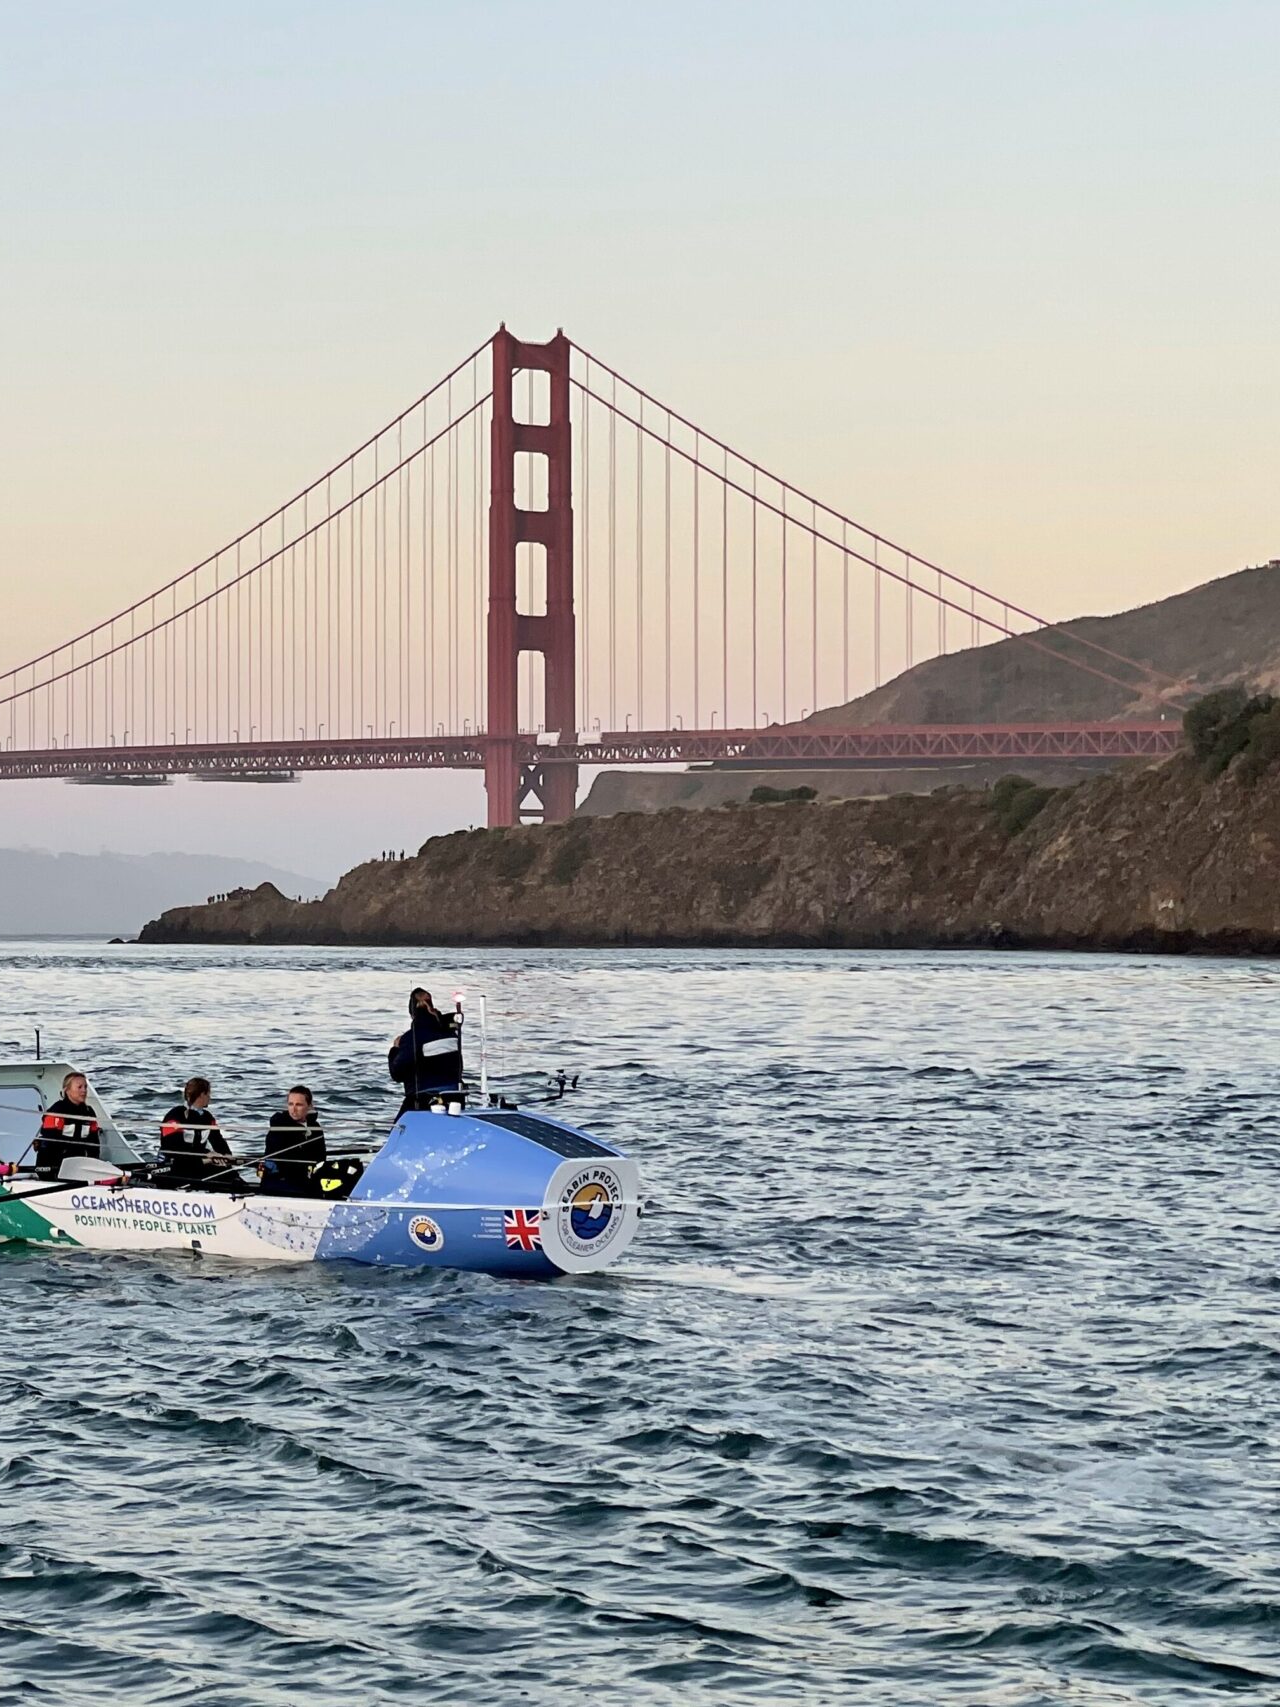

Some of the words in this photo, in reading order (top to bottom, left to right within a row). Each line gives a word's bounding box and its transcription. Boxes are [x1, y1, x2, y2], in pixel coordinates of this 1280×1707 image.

[71, 1194, 215, 1219] OCEANSHEROES.COM
[562, 1172, 590, 1213] SEABIN
[593, 1170, 622, 1211] PROJECT
[74, 1214, 131, 1230] POSITIVITY.
[133, 1219, 175, 1233] PEOPLE.
[177, 1222, 217, 1236] PLANET
[566, 1235, 595, 1252] CLEANER
[595, 1215, 619, 1247] OCEANS
